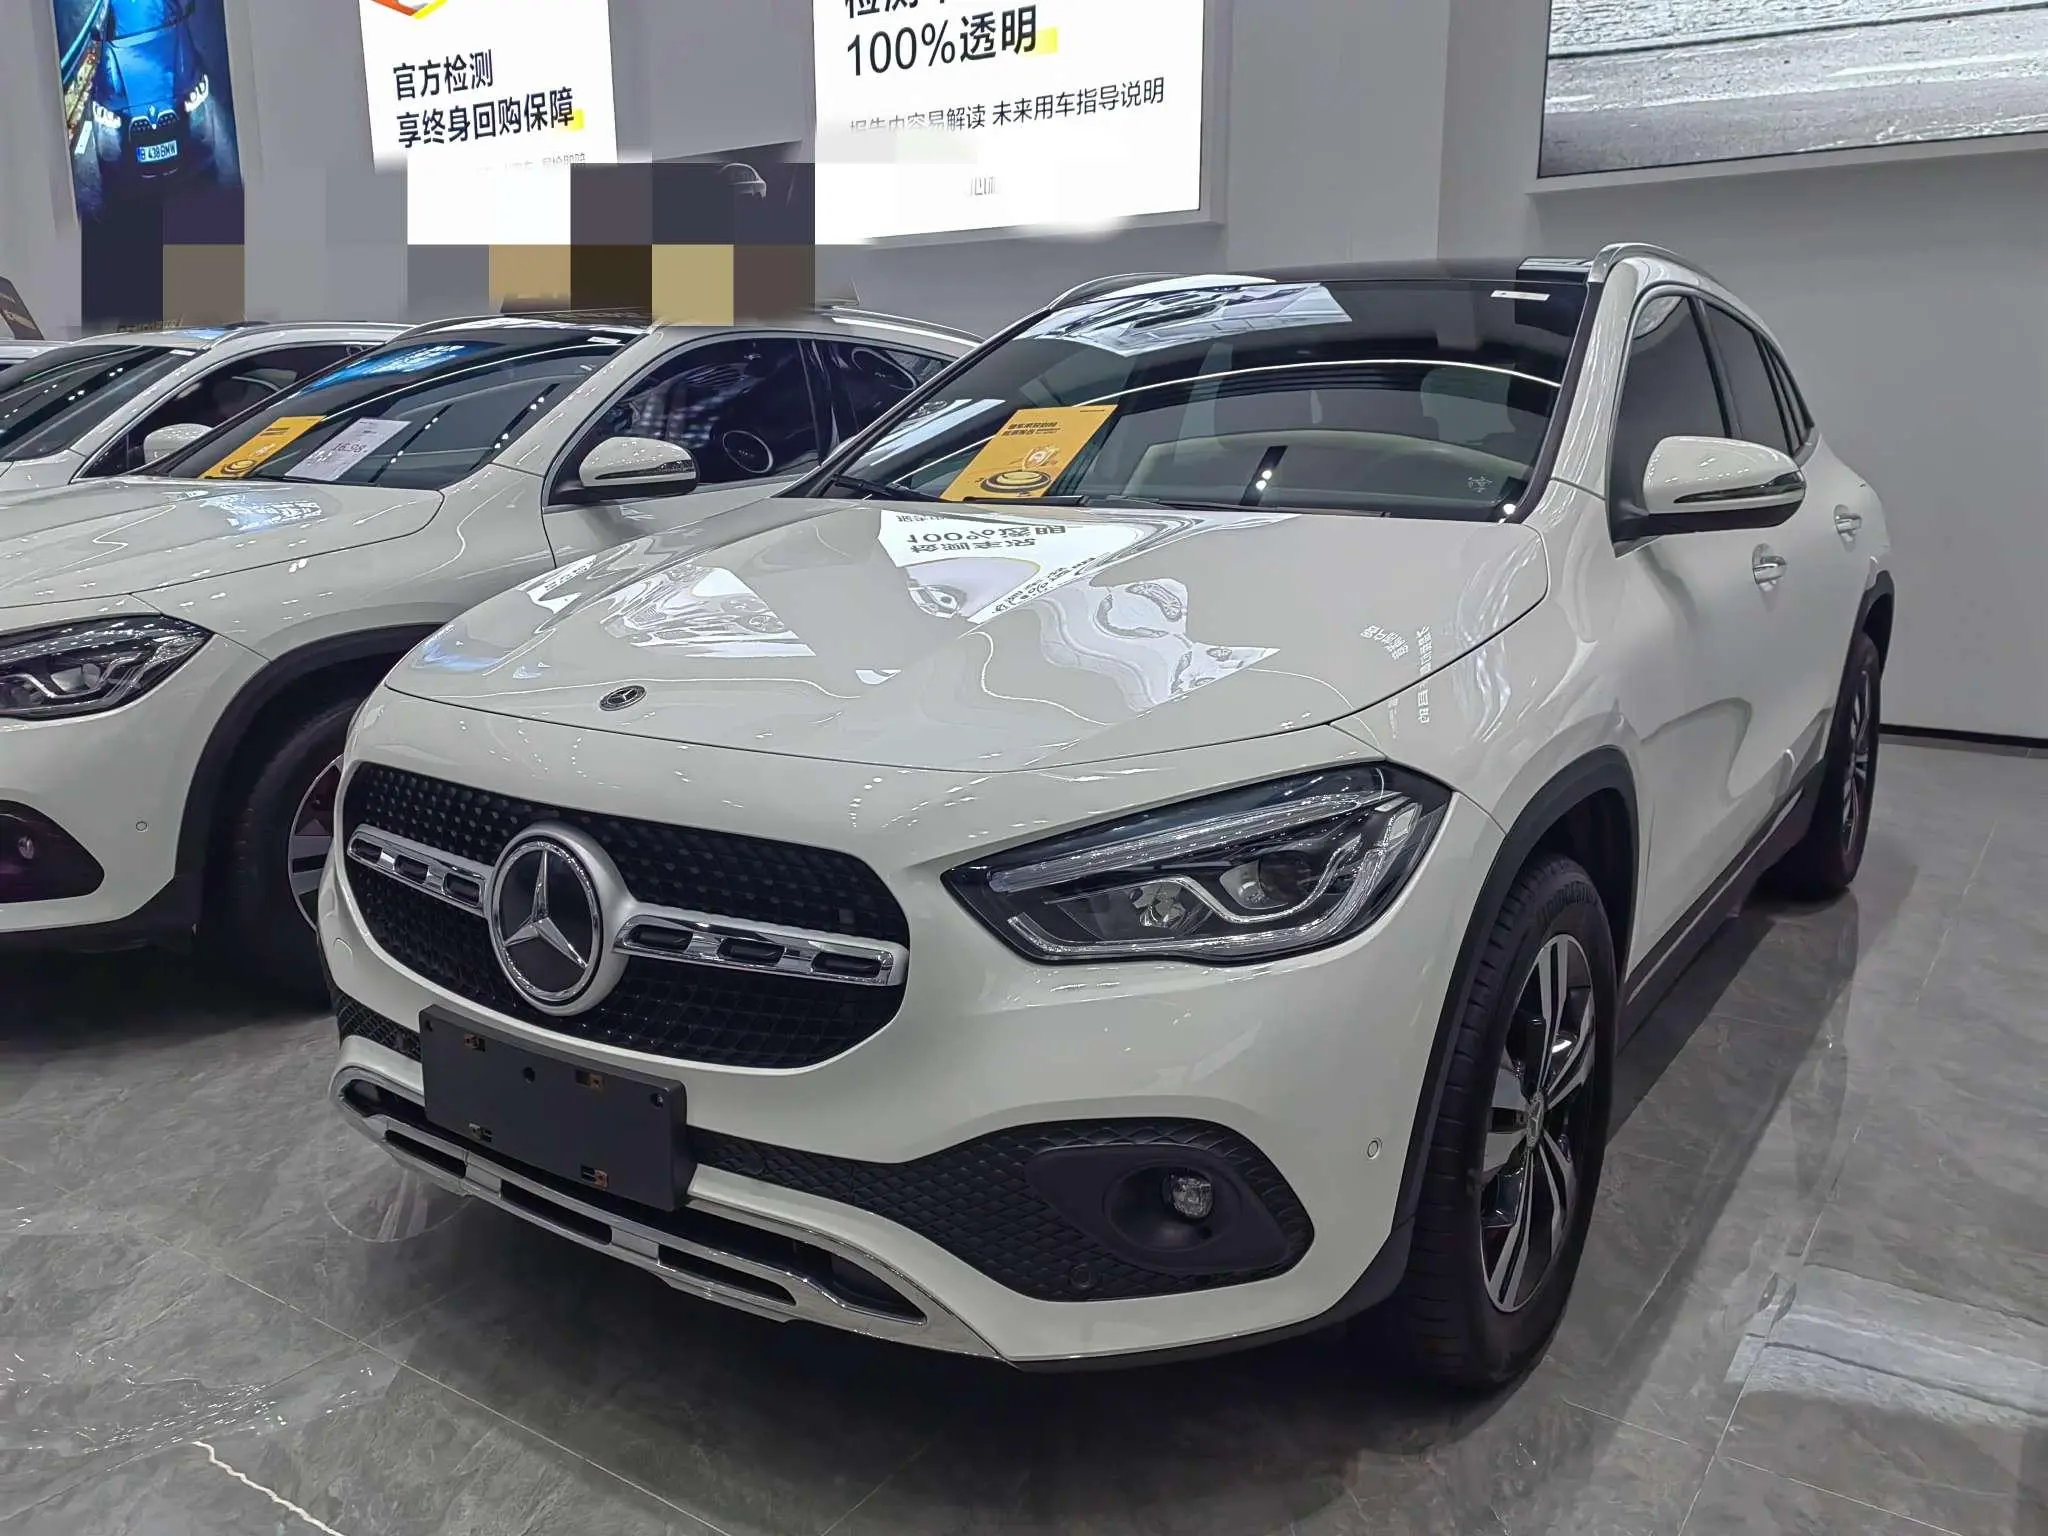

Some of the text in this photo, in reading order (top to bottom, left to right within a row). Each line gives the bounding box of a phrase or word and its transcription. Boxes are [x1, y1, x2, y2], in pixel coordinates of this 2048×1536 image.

[846, 4, 1037, 77] 100%透明
[393, 49, 493, 100] 官方检测
[992, 76, 1165, 126] 未来用车指导说明
[397, 87, 574, 149] 享终身回购保障
